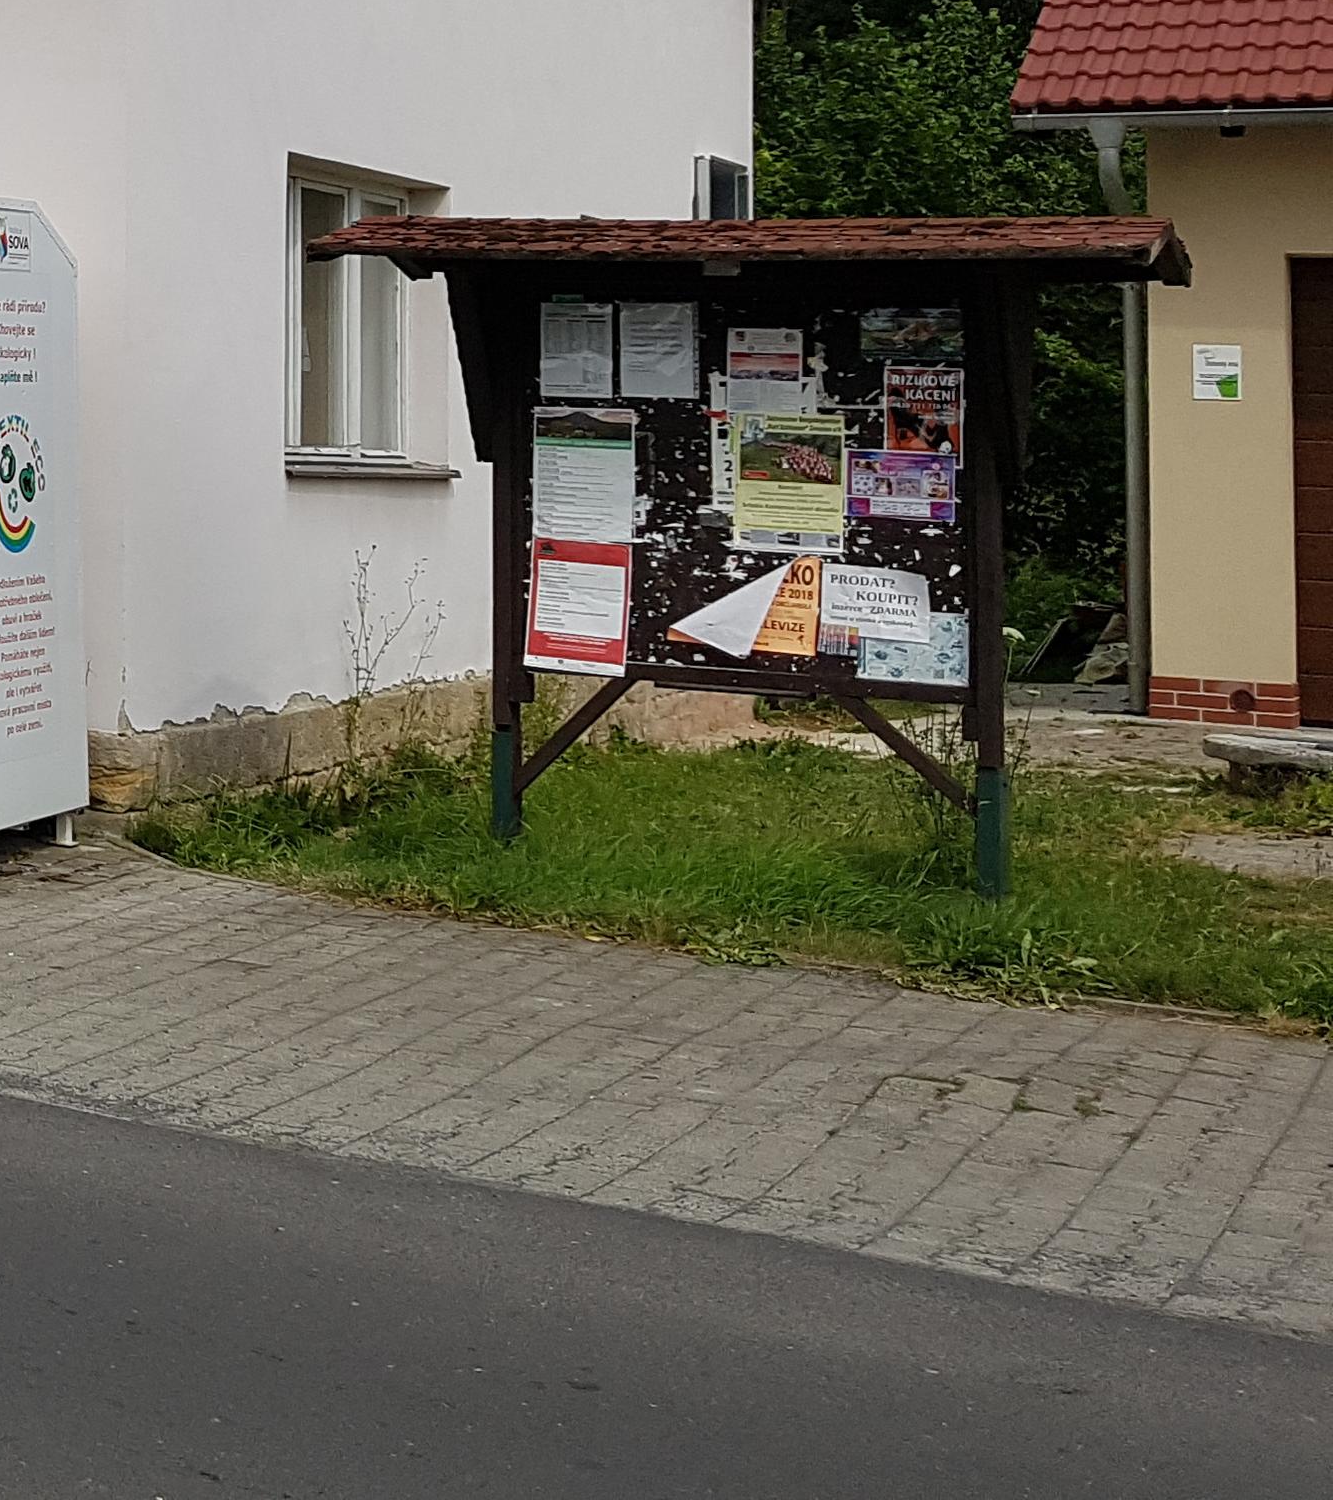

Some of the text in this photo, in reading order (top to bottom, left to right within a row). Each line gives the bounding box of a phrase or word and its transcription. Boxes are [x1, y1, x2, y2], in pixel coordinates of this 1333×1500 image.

[8, 235, 29, 250] SOVA
[31, 438, 45, 491] ECO
[784, 564, 814, 586] KO
[830, 573, 895, 588] PRODAT?
[788, 588, 814, 601] 2018
[855, 591, 919, 606] KOUPIT?
[869, 606, 917, 618] ZDARMA
[762, 620, 805, 633] LEVIZE
